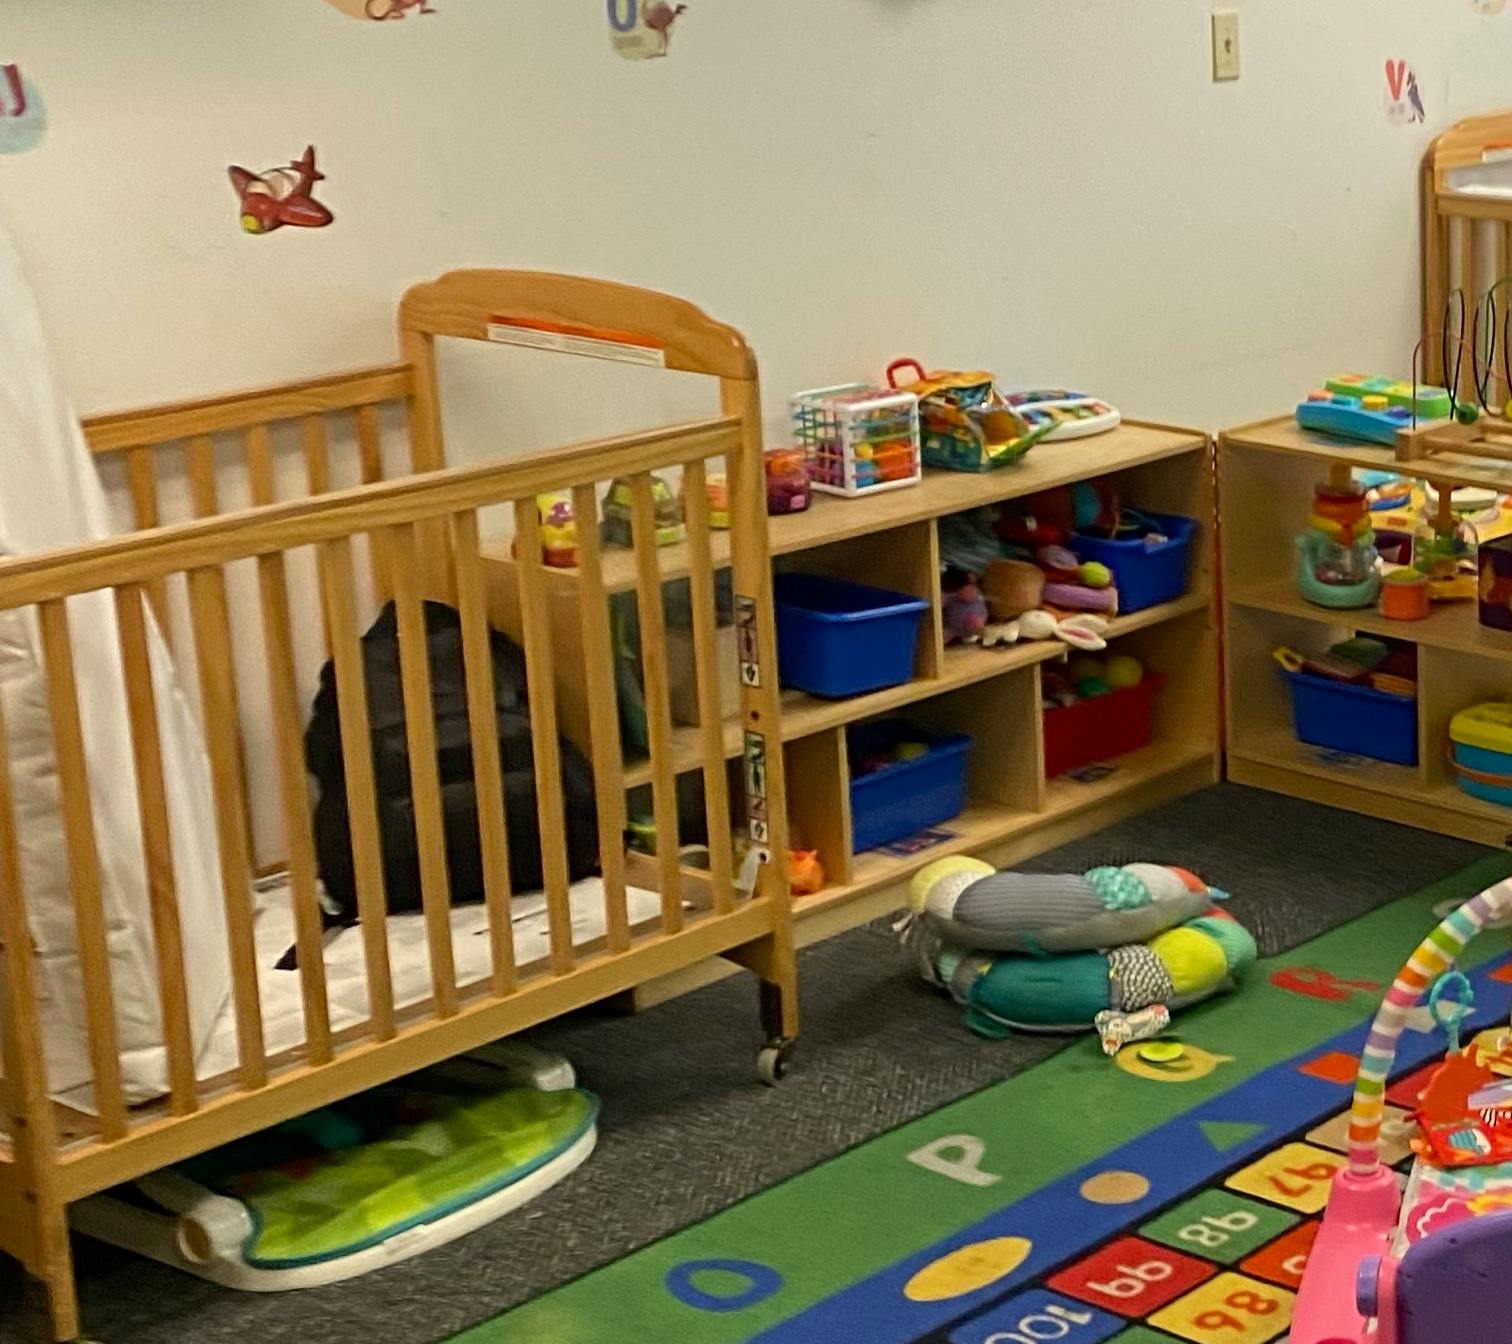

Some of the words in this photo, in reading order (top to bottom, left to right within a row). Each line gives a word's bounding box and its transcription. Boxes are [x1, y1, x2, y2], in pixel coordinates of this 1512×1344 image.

[1385, 58, 1406, 101] V
[907, 1134, 1001, 1187] P
[1178, 1211, 1259, 1247] 98
[1086, 1260, 1172, 1298] 99
[1194, 1290, 1280, 1333] 86
